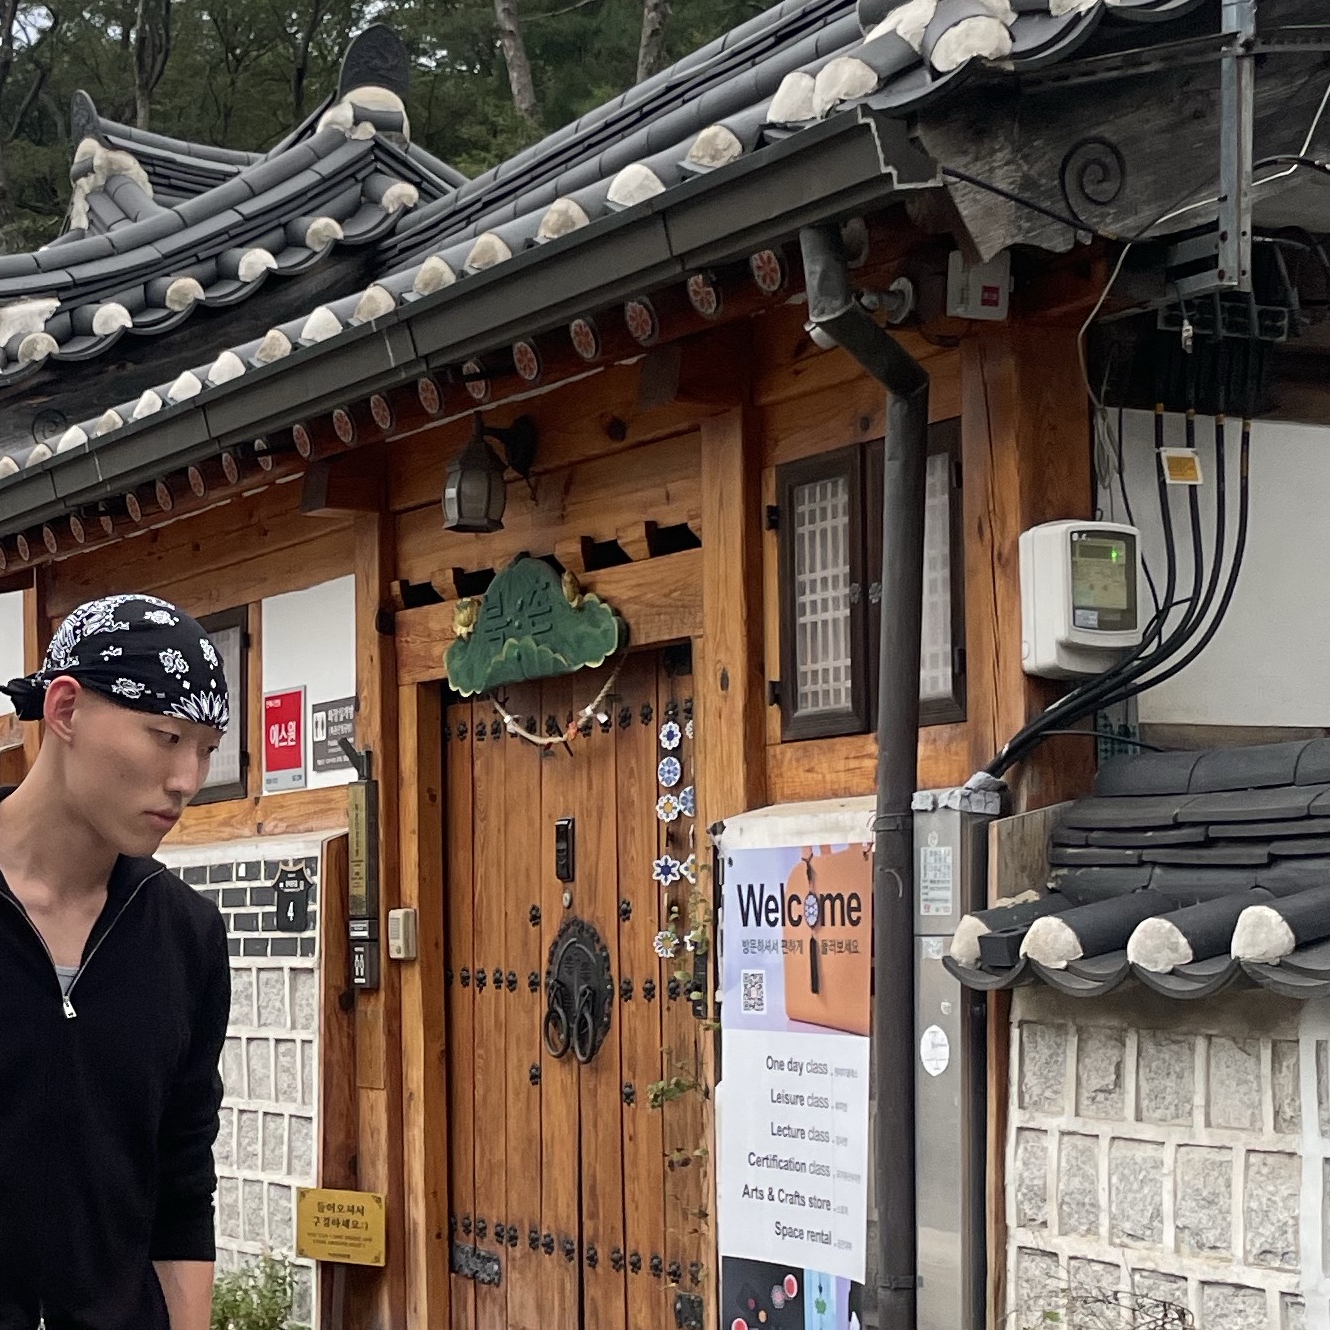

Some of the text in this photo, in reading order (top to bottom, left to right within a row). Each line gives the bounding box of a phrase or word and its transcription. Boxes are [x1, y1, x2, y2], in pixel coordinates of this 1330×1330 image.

[269, 720, 297, 748] 에스원
[736, 883, 862, 928] Welcome
[766, 1055, 785, 1071] One
[787, 1057, 804, 1076] day
[806, 1058, 828, 1075] class
[770, 1088, 805, 1106] Leisure
[807, 1092, 829, 1109] class
[771, 1122, 806, 1139] Lecture
[808, 1126, 830, 1143] class
[748, 1151, 807, 1173] Certification
[809, 1160, 831, 1177] class
[742, 1184, 764, 1201] Arts
[767, 1187, 775, 1202] &
[777, 1189, 806, 1207] Crafts
[808, 1196, 831, 1212] store
[774, 1220, 804, 1240] Space
[806, 1229, 832, 1245] rental
